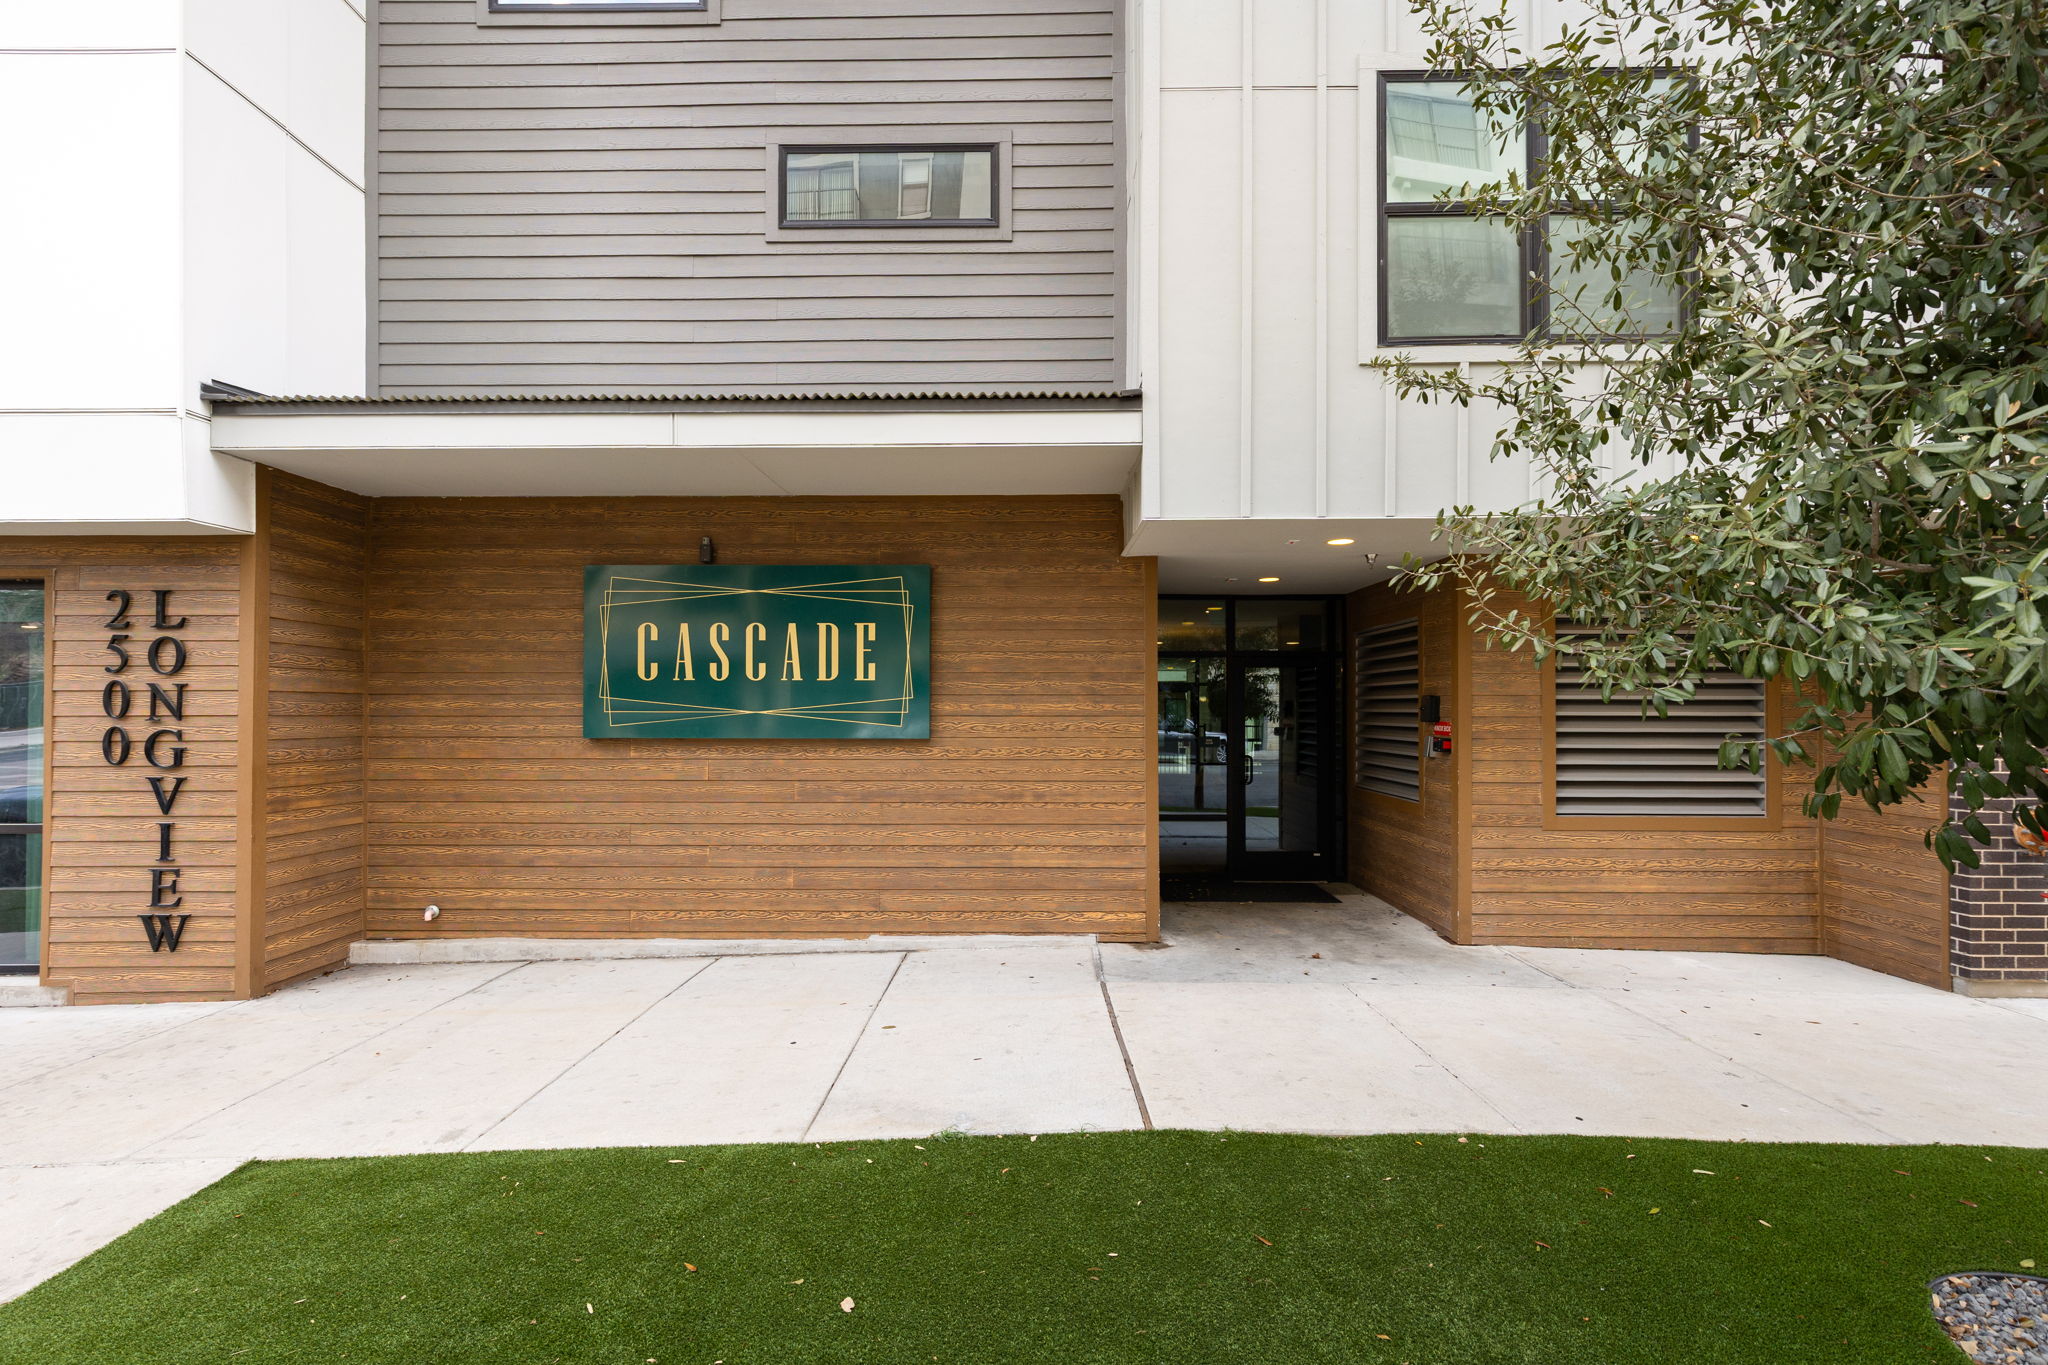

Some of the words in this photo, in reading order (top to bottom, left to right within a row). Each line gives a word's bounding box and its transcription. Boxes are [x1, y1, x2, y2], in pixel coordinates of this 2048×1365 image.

[102, 590, 131, 766] 2500
[637, 622, 876, 682] CASCADE
[137, 590, 192, 953] LONGVIEW
